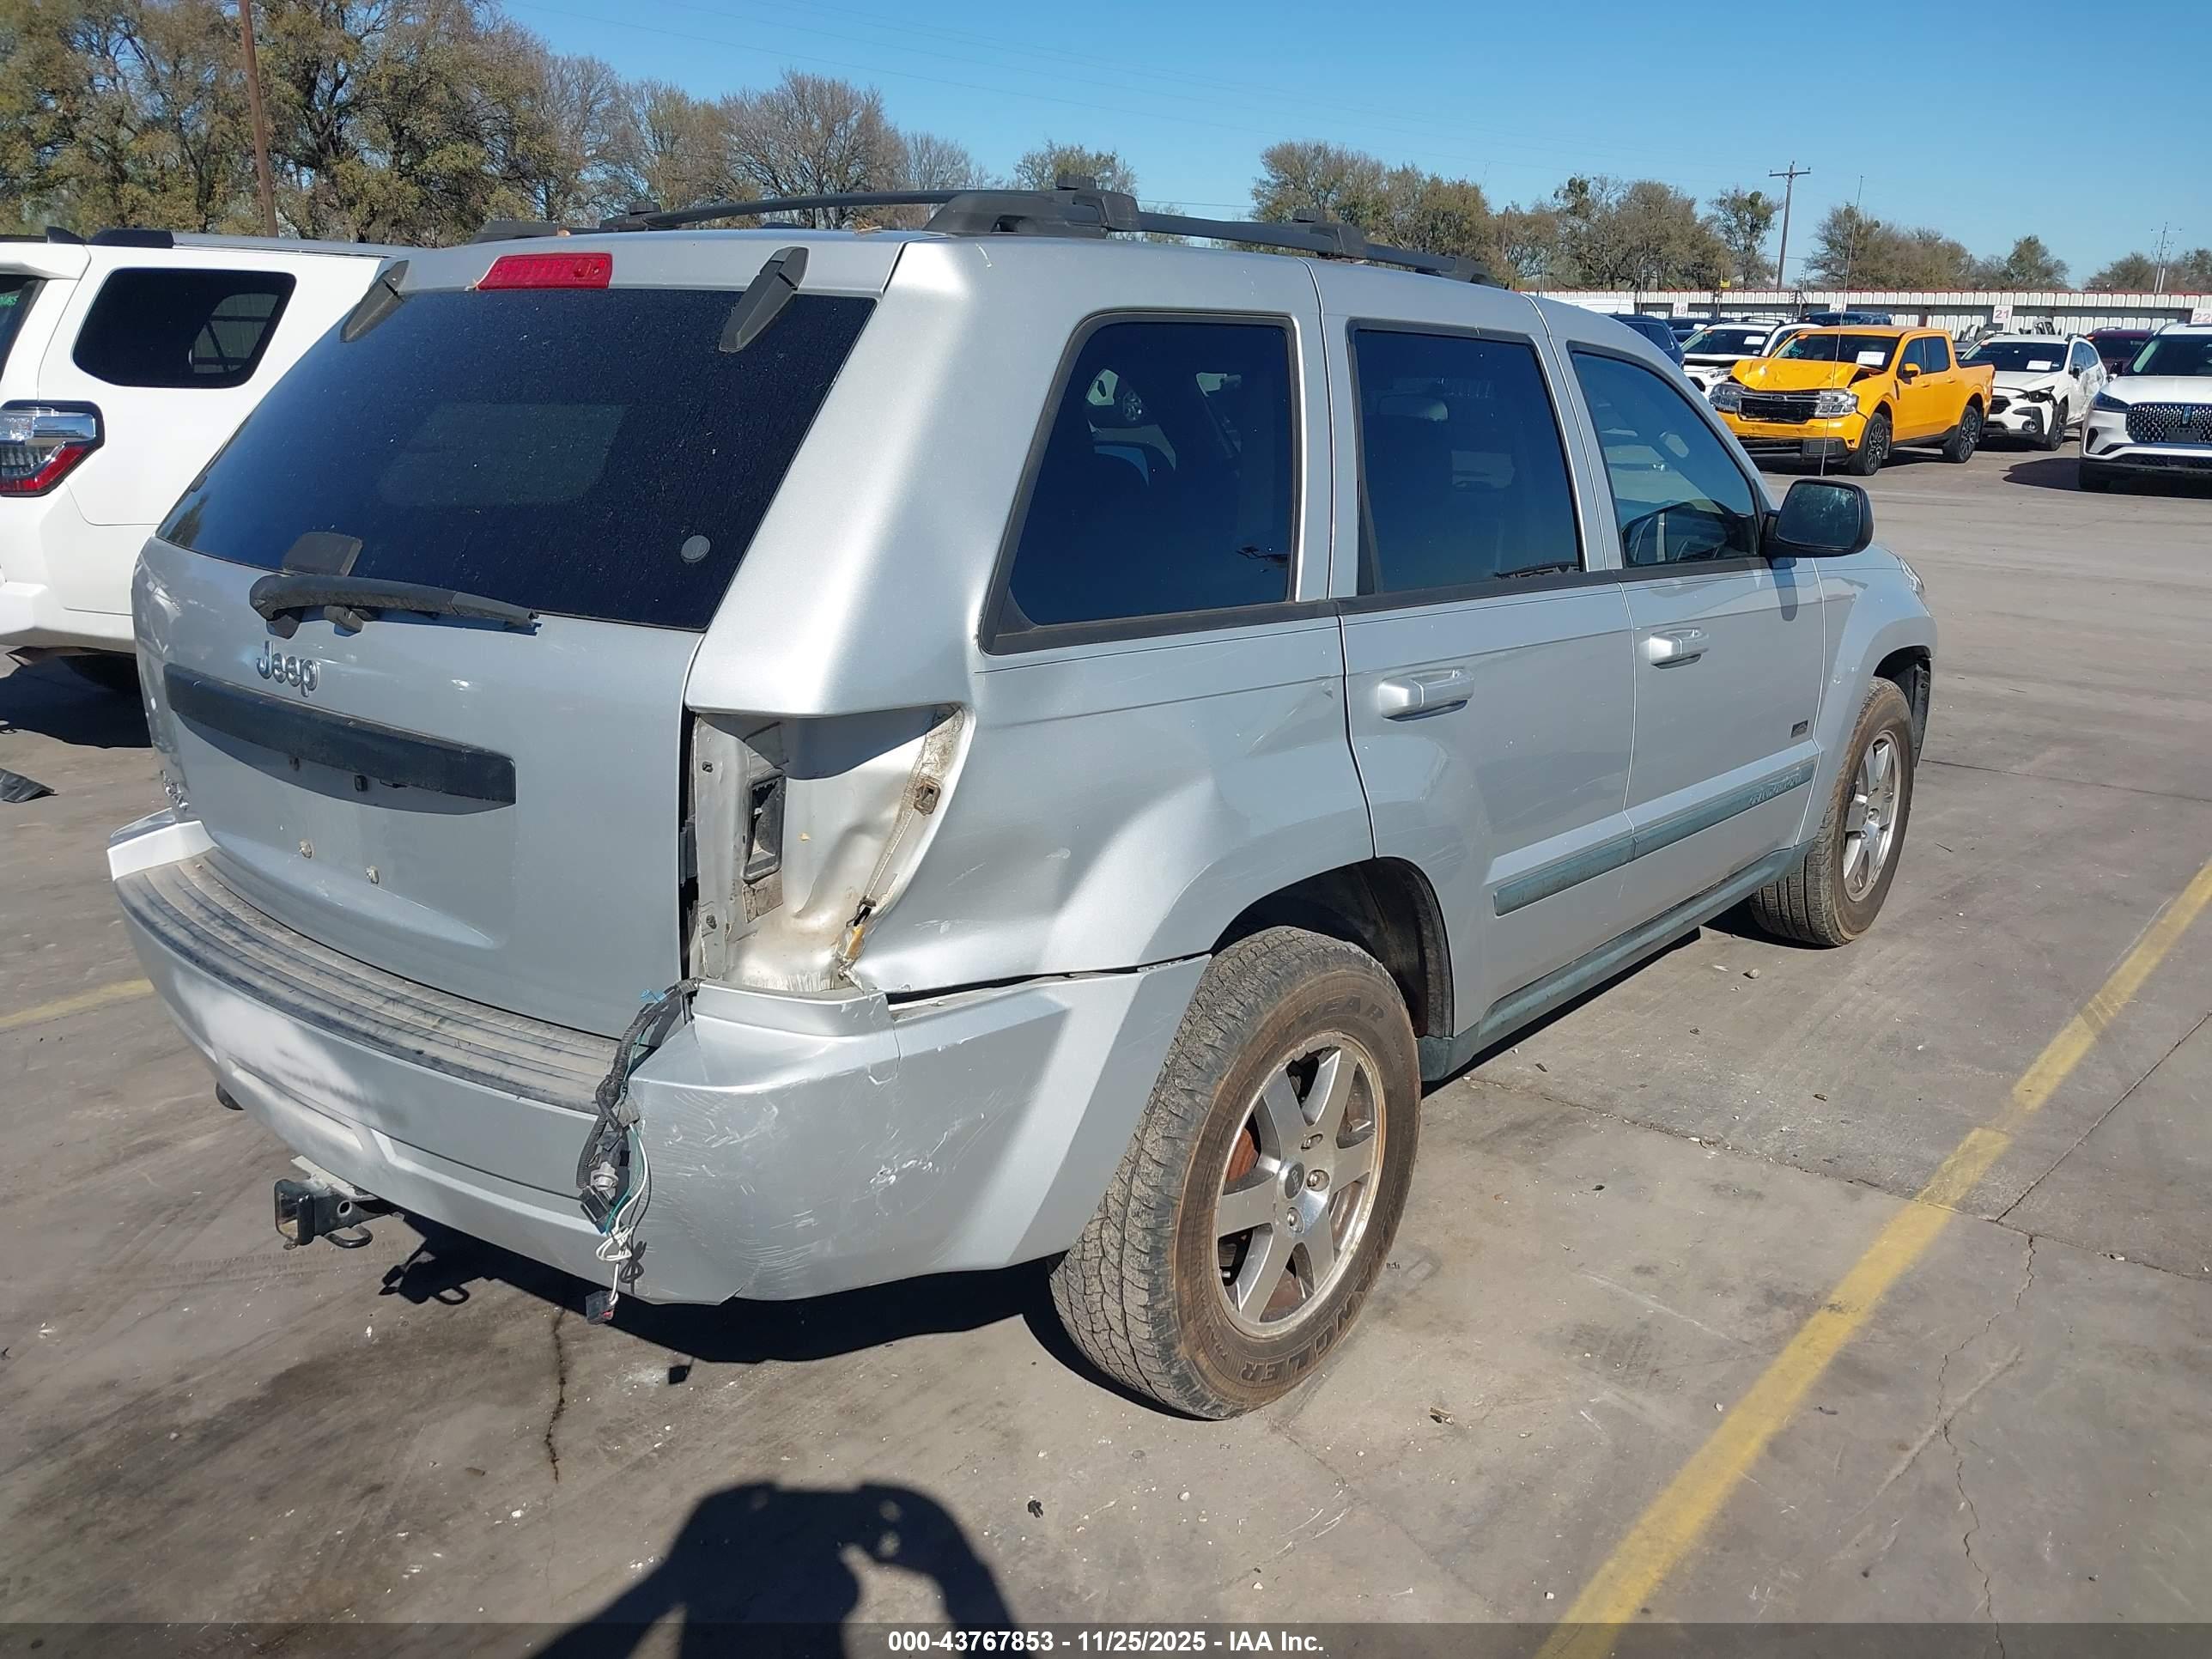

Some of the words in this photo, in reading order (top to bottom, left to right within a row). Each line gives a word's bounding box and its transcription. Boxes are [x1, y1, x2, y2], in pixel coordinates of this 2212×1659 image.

[1674, 306, 1687, 315] 19
[1995, 309, 2009, 319] 21
[2192, 313, 2211, 323] 22
[256, 640, 320, 698] Jeep
